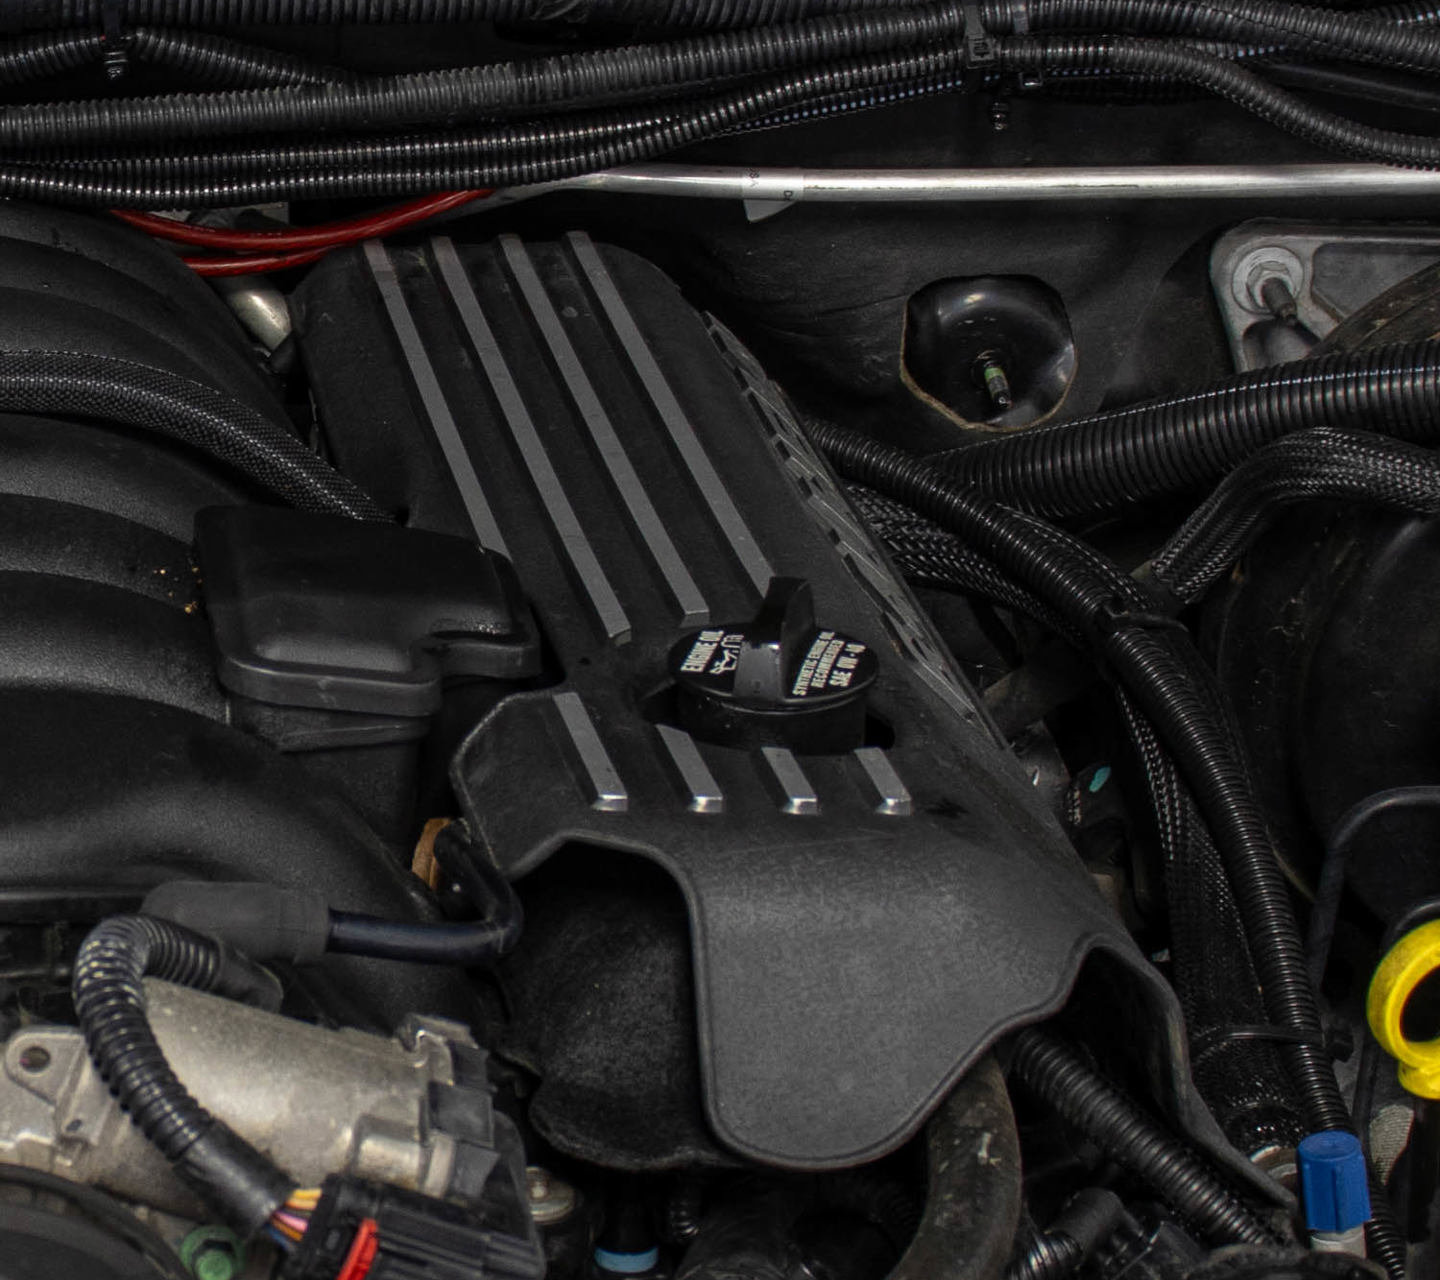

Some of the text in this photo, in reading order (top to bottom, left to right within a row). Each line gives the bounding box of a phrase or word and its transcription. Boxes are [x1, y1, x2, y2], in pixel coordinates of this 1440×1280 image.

[680, 641, 718, 672] ENGINE
[811, 639, 845, 688] RECOMMENDED
[829, 670, 853, 687] SAE
